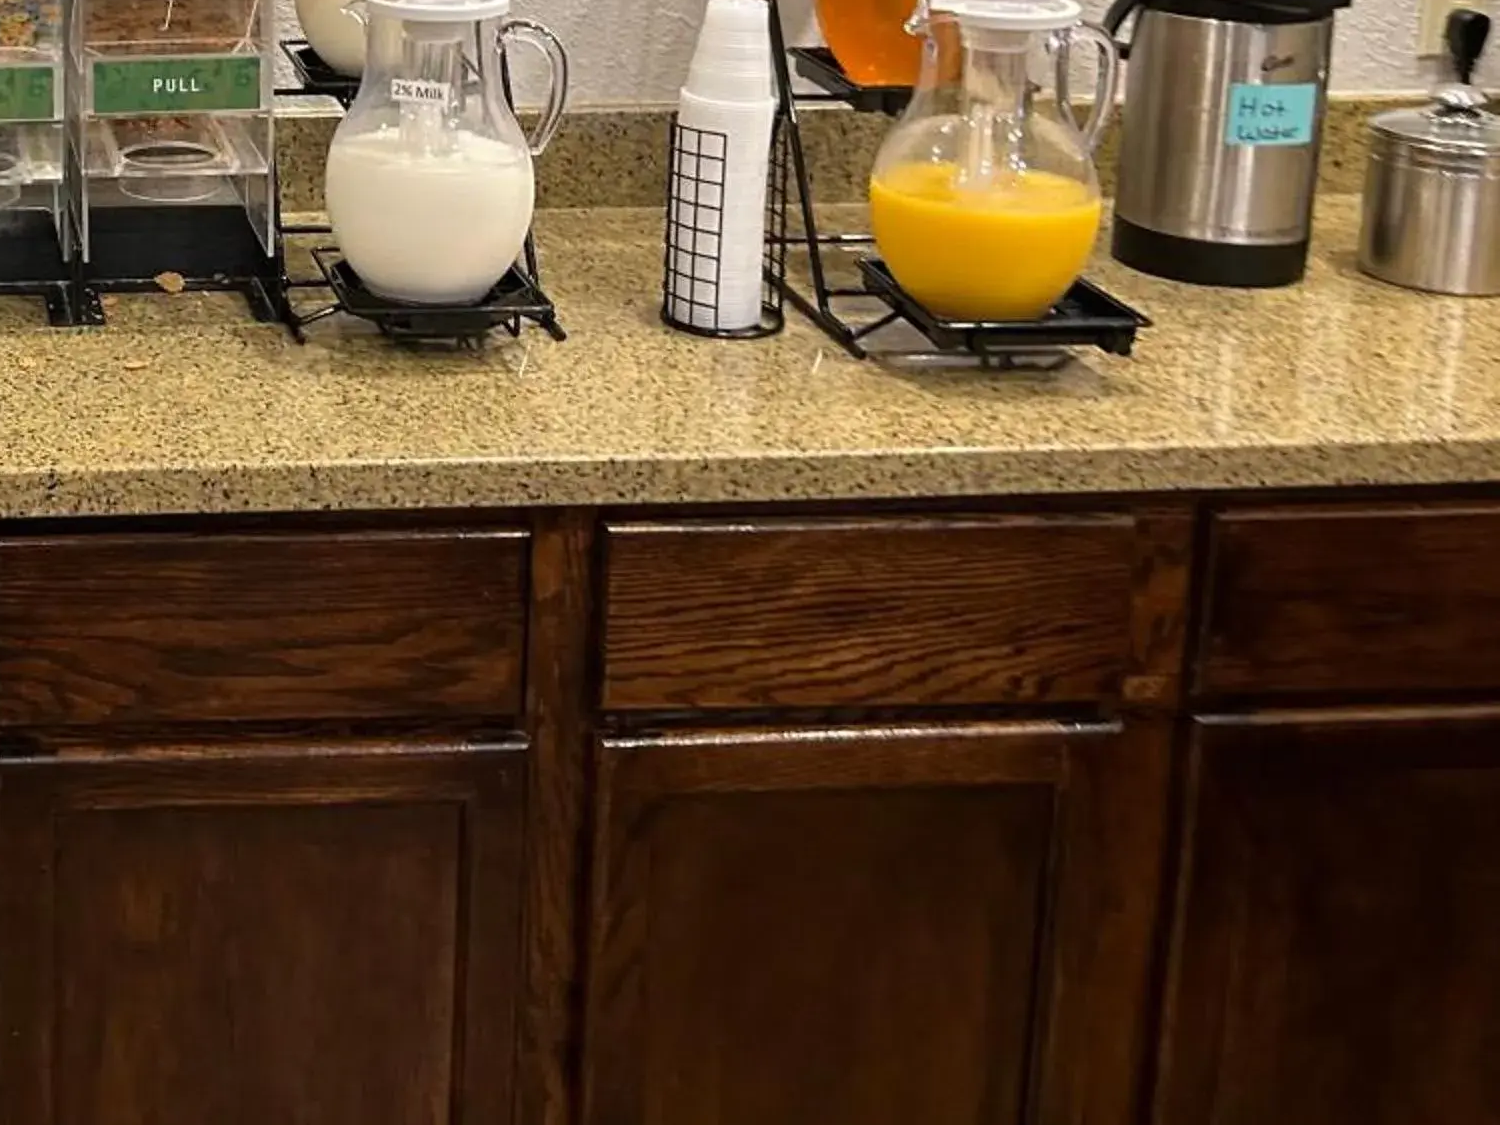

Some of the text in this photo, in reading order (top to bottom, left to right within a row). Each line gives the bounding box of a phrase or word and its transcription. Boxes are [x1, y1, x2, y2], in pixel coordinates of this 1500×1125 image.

[153, 78, 200, 93] PULL
[415, 85, 444, 100] Milk
[1238, 96, 1290, 116] Hot
